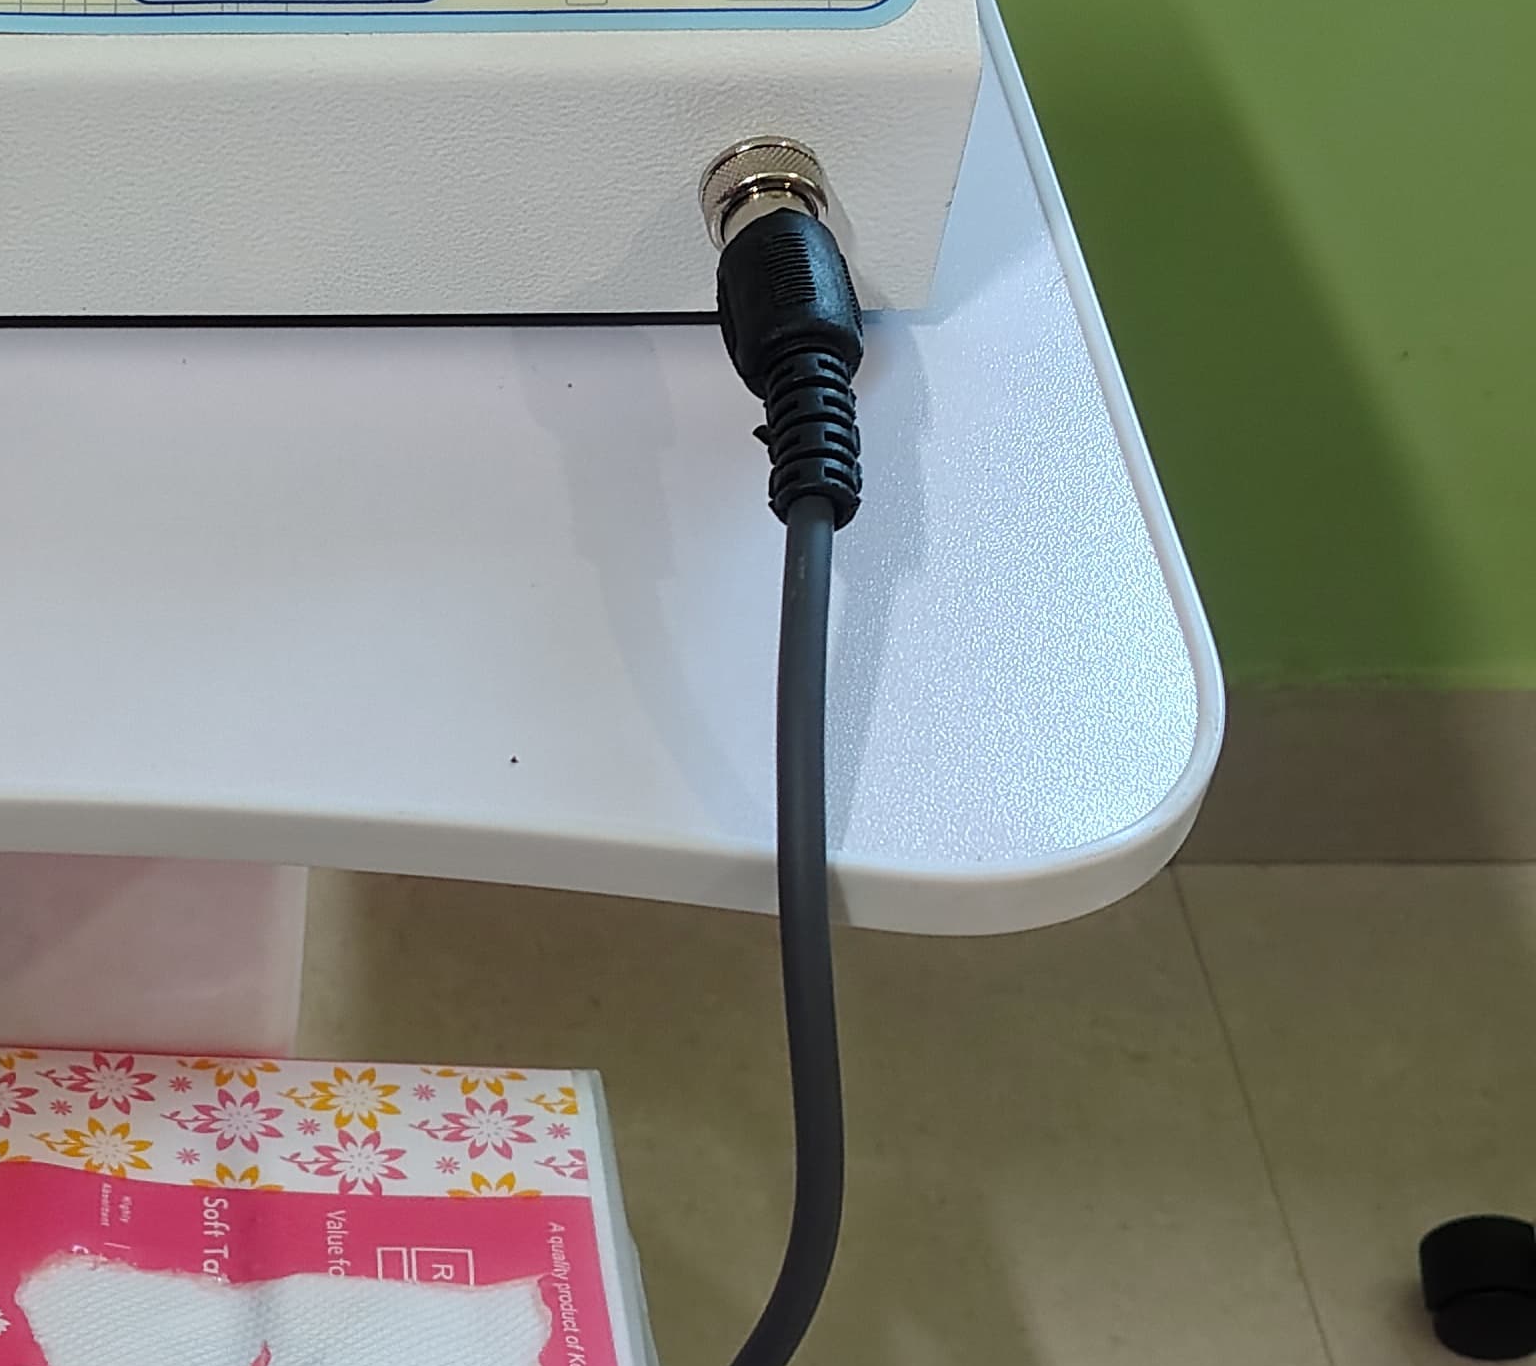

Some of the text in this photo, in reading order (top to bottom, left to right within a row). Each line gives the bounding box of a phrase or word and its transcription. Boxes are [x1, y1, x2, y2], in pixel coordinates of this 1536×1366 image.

[203, 1196, 230, 1237] Soft
[547, 1221, 566, 1233] A
[326, 1210, 352, 1277] Value fo
[546, 1235, 571, 1279] quality
[552, 1282, 581, 1333] product
[565, 1336, 585, 1354] of
